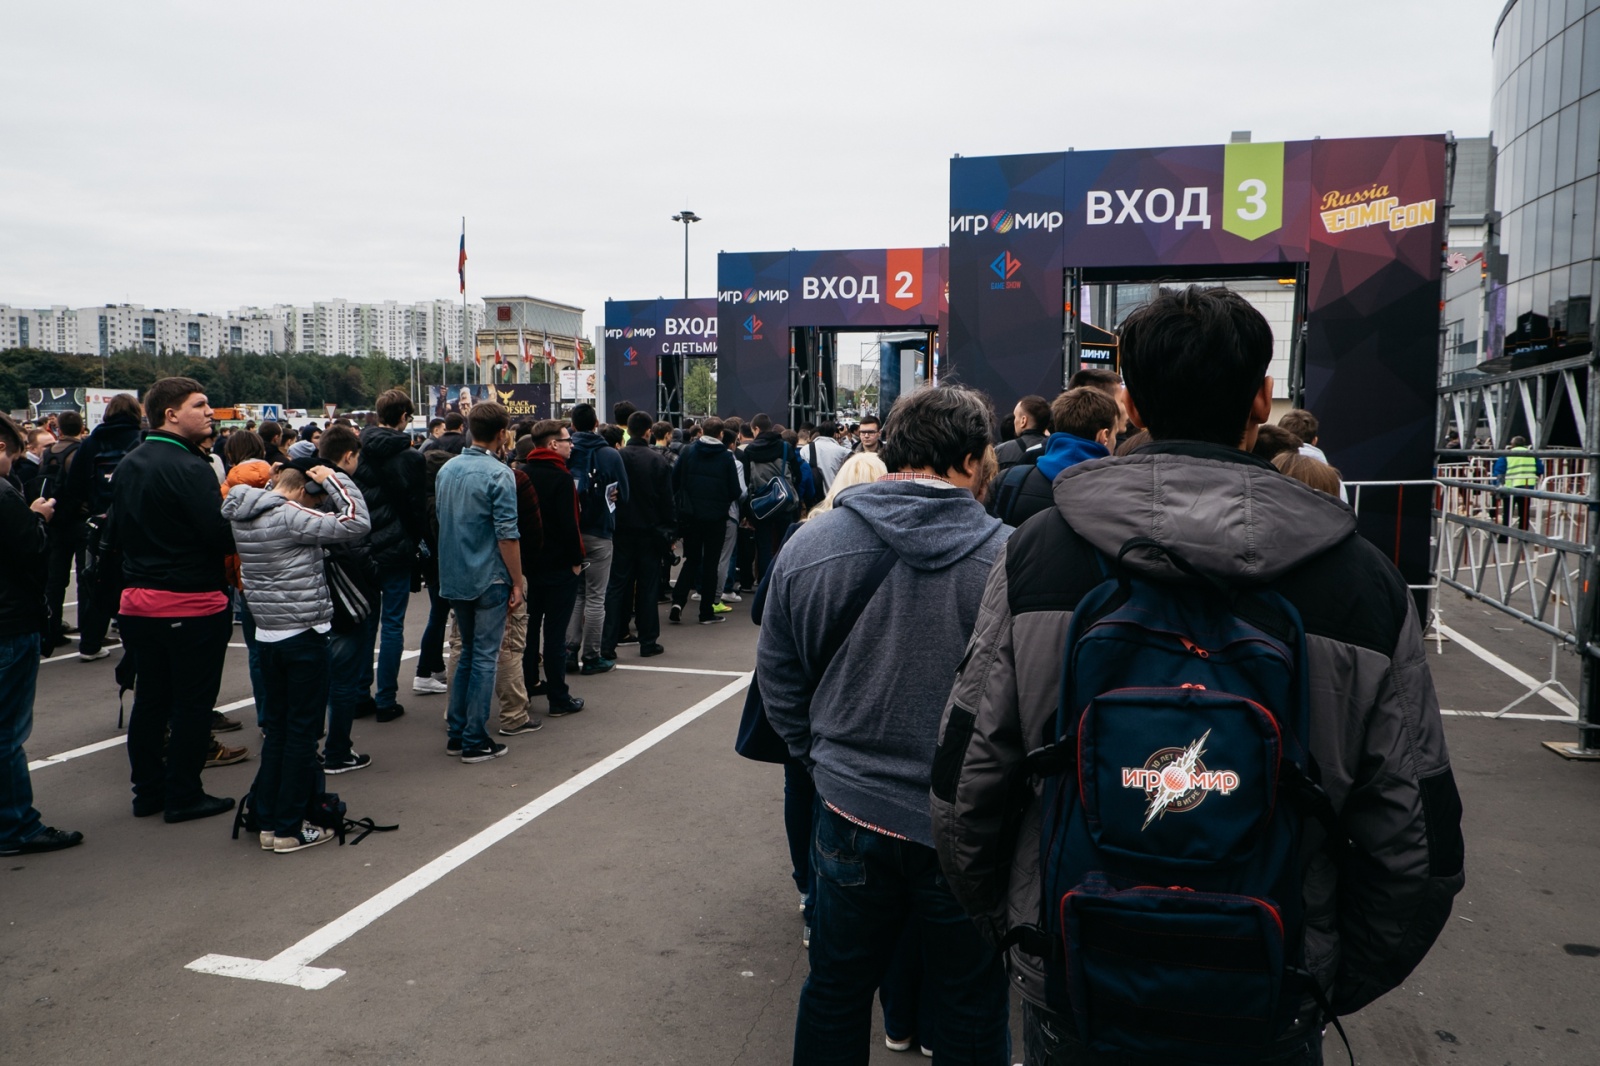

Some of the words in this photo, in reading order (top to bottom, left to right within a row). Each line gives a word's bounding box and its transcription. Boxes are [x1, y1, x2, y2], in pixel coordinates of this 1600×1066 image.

[1086, 187, 1212, 230] ВХОД
[1236, 178, 1267, 221] 3
[1320, 183, 1389, 211] Russia
[1320, 196, 1399, 233] COMIC
[1389, 199, 1436, 232] CON
[803, 275, 880, 304] ВХОД
[894, 271, 914, 298] 2
[990, 281, 1005, 290] GAME
[665, 317, 718, 338] ВХОД
[661, 342, 669, 353] С
[508, 400, 529, 408] BLACK
[1151, 759, 1161, 769] 10
[1160, 753, 1174, 763] ЛЕТ
[1183, 790, 1201, 806] ИГРЕ
